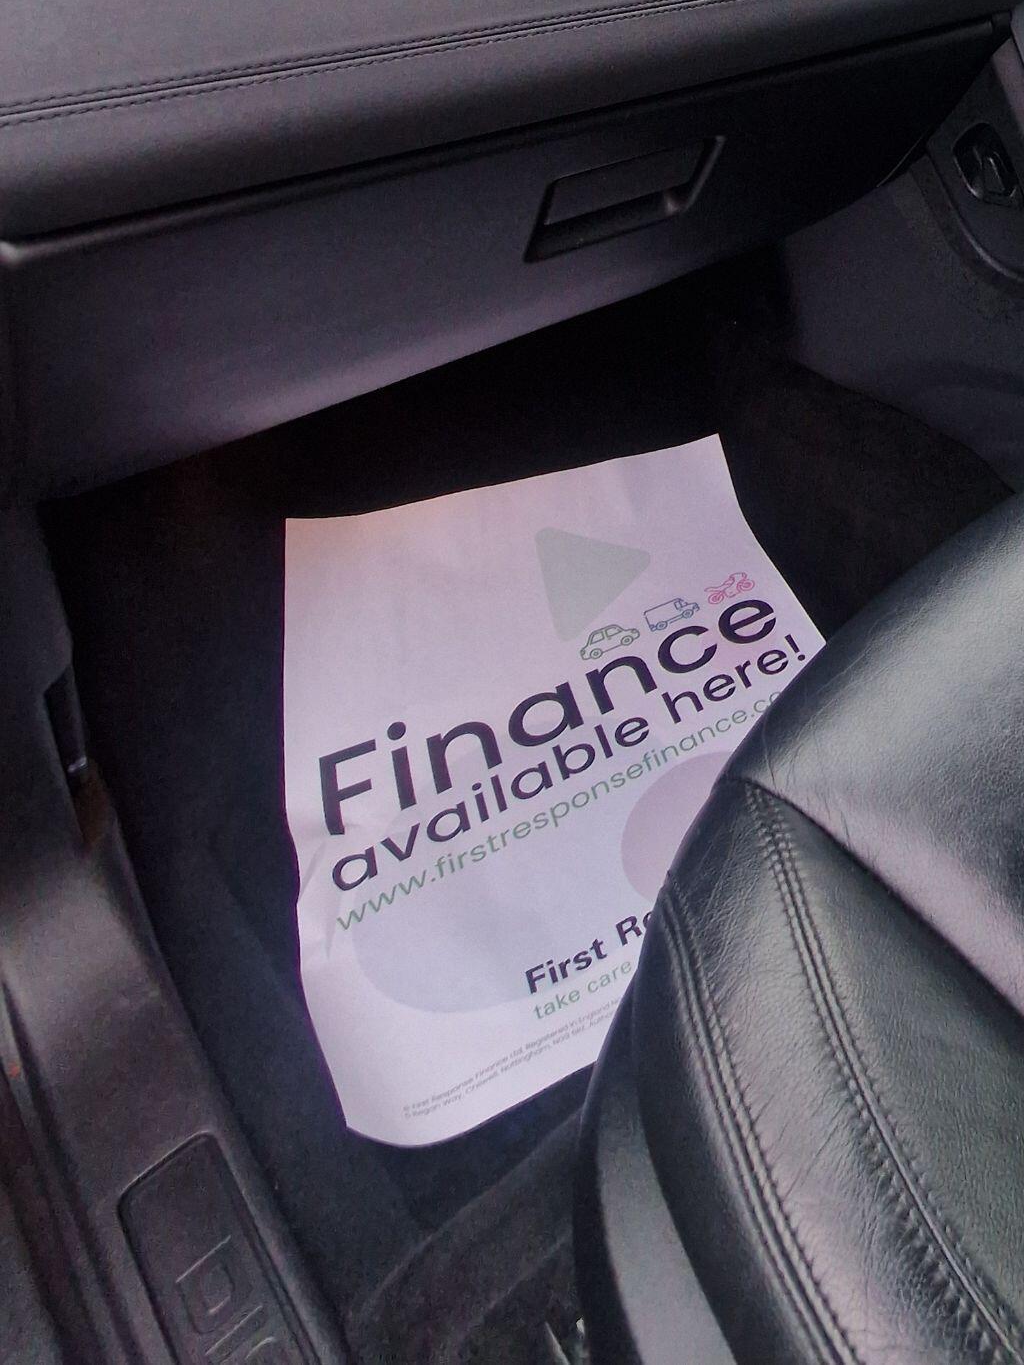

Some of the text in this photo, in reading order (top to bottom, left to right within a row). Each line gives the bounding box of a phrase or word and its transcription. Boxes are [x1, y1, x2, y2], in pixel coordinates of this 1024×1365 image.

[319, 599, 776, 835] Finance
[332, 634, 806, 891] available here!
[525, 938, 608, 994] First
[534, 989, 581, 1019] take
[587, 961, 633, 994] care
